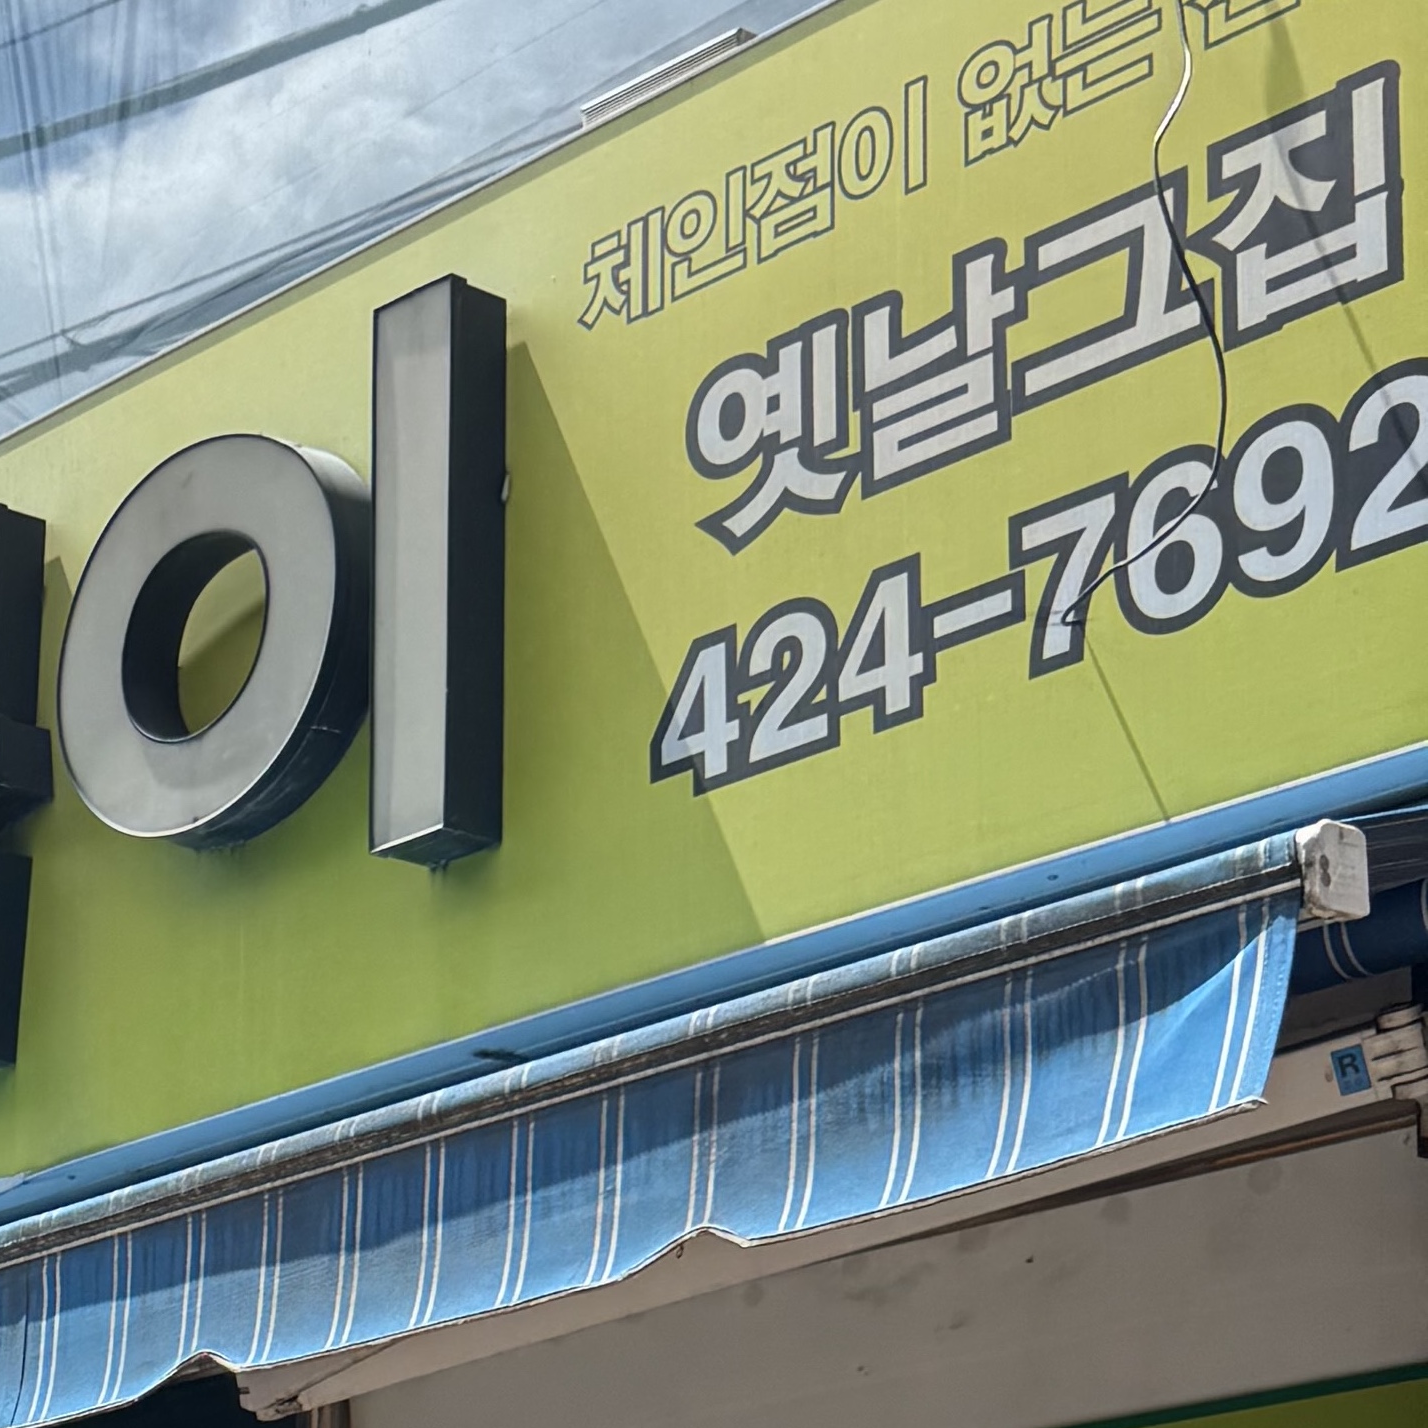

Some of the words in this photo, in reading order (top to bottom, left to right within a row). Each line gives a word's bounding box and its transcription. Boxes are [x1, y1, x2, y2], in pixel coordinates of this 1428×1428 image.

[577, 74, 928, 330] 체인점이
[958, 0, 1163, 167] 없는
[684, 60, 1405, 556] 옛날그집
[649, 355, 1428, 798] 424-7692
[1337, 1053, 1361, 1078] R
